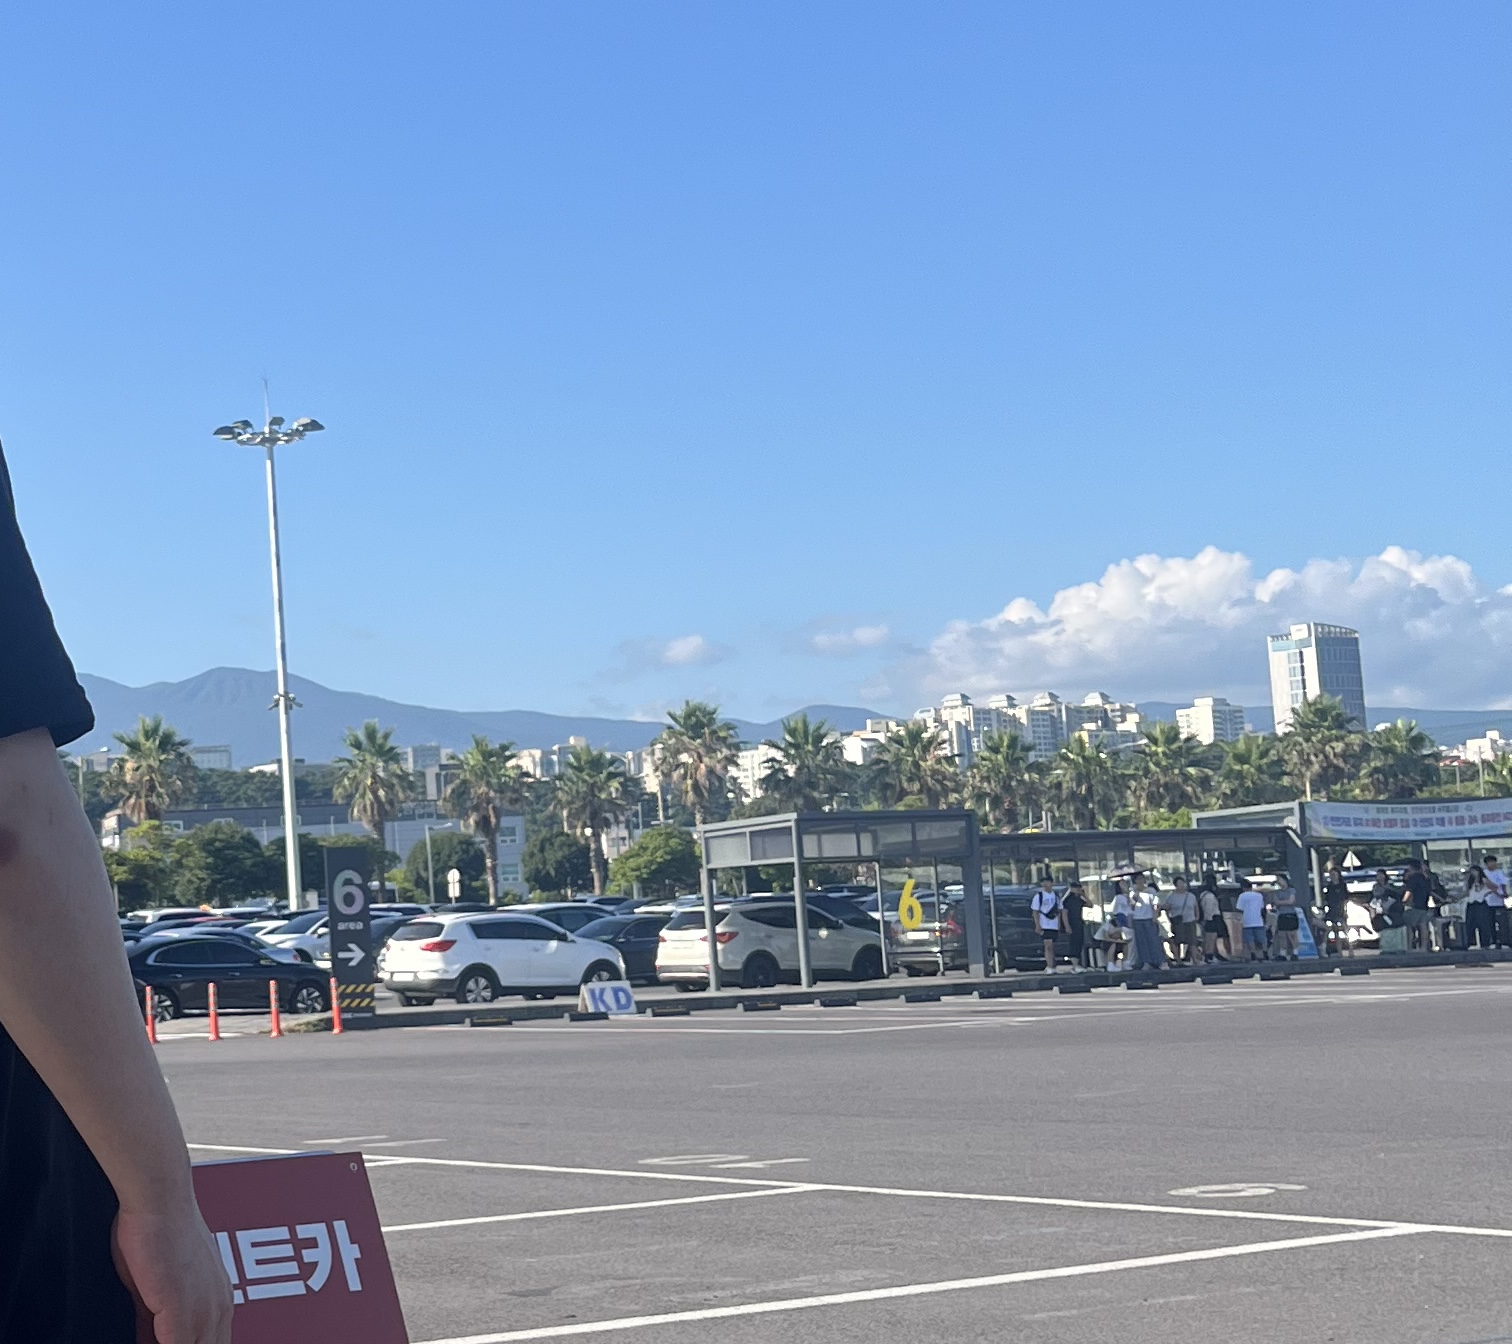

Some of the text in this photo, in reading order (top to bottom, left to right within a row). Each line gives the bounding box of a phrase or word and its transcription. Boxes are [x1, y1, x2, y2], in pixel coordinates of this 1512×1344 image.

[333, 869, 365, 916] 6
[898, 878, 924, 931] 6
[337, 921, 364, 931] area
